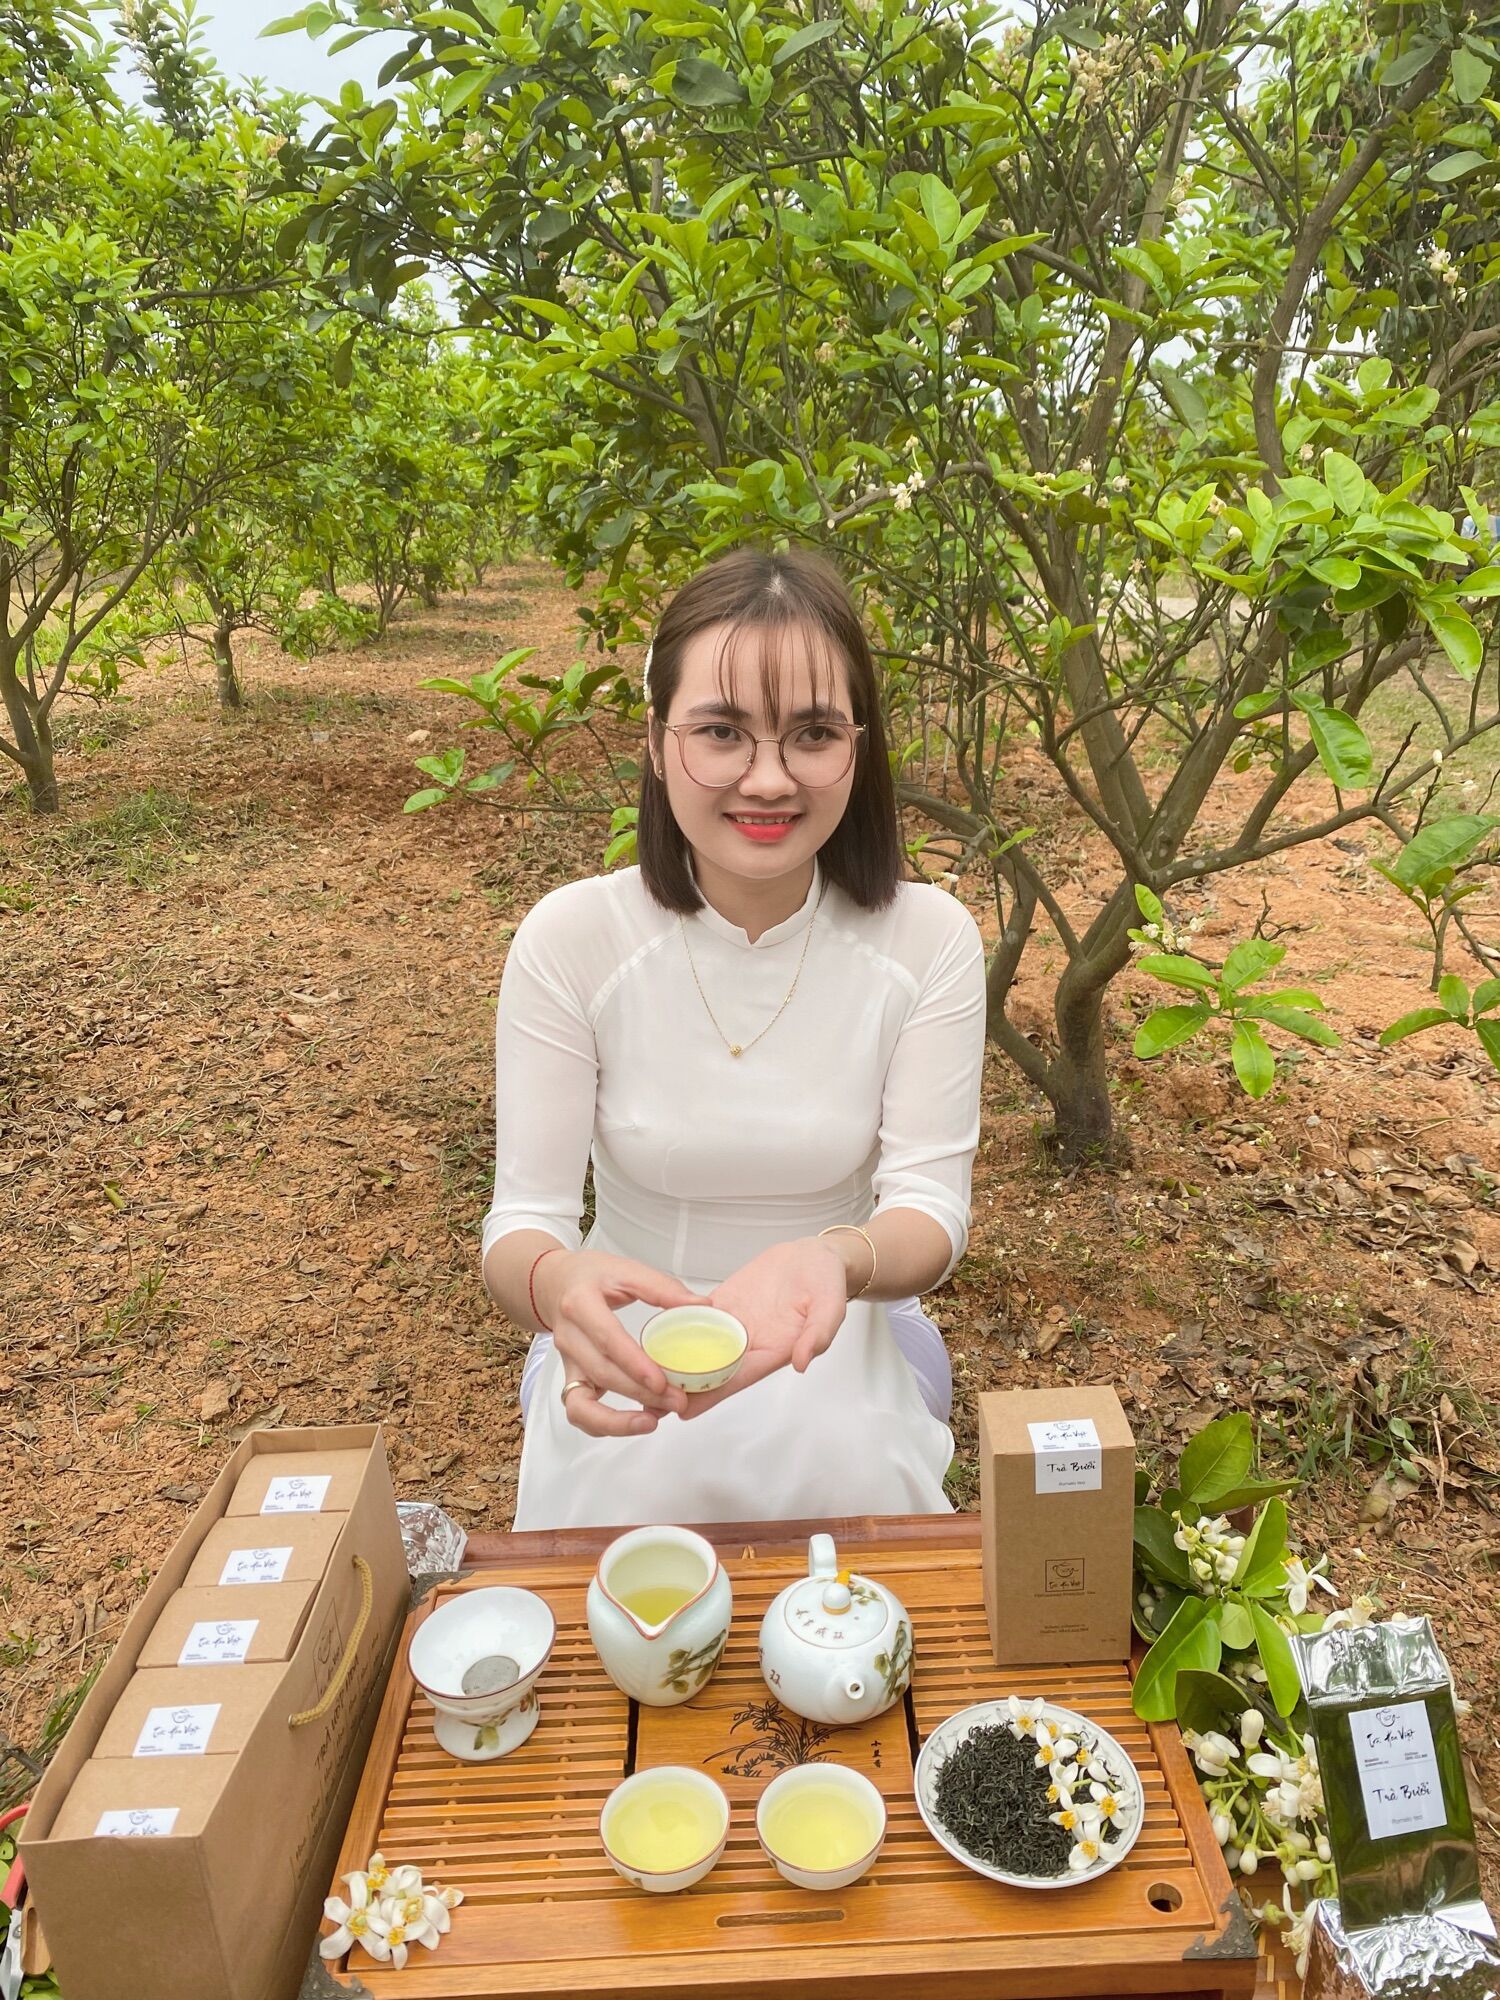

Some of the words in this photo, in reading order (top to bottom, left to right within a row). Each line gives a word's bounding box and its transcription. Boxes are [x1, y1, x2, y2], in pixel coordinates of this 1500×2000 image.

[1046, 1463, 1067, 1473] Trà
[1070, 1460, 1096, 1472] Bưởi
[1372, 1786, 1399, 1804] Trà
[1400, 1781, 1432, 1799] Bưởi
